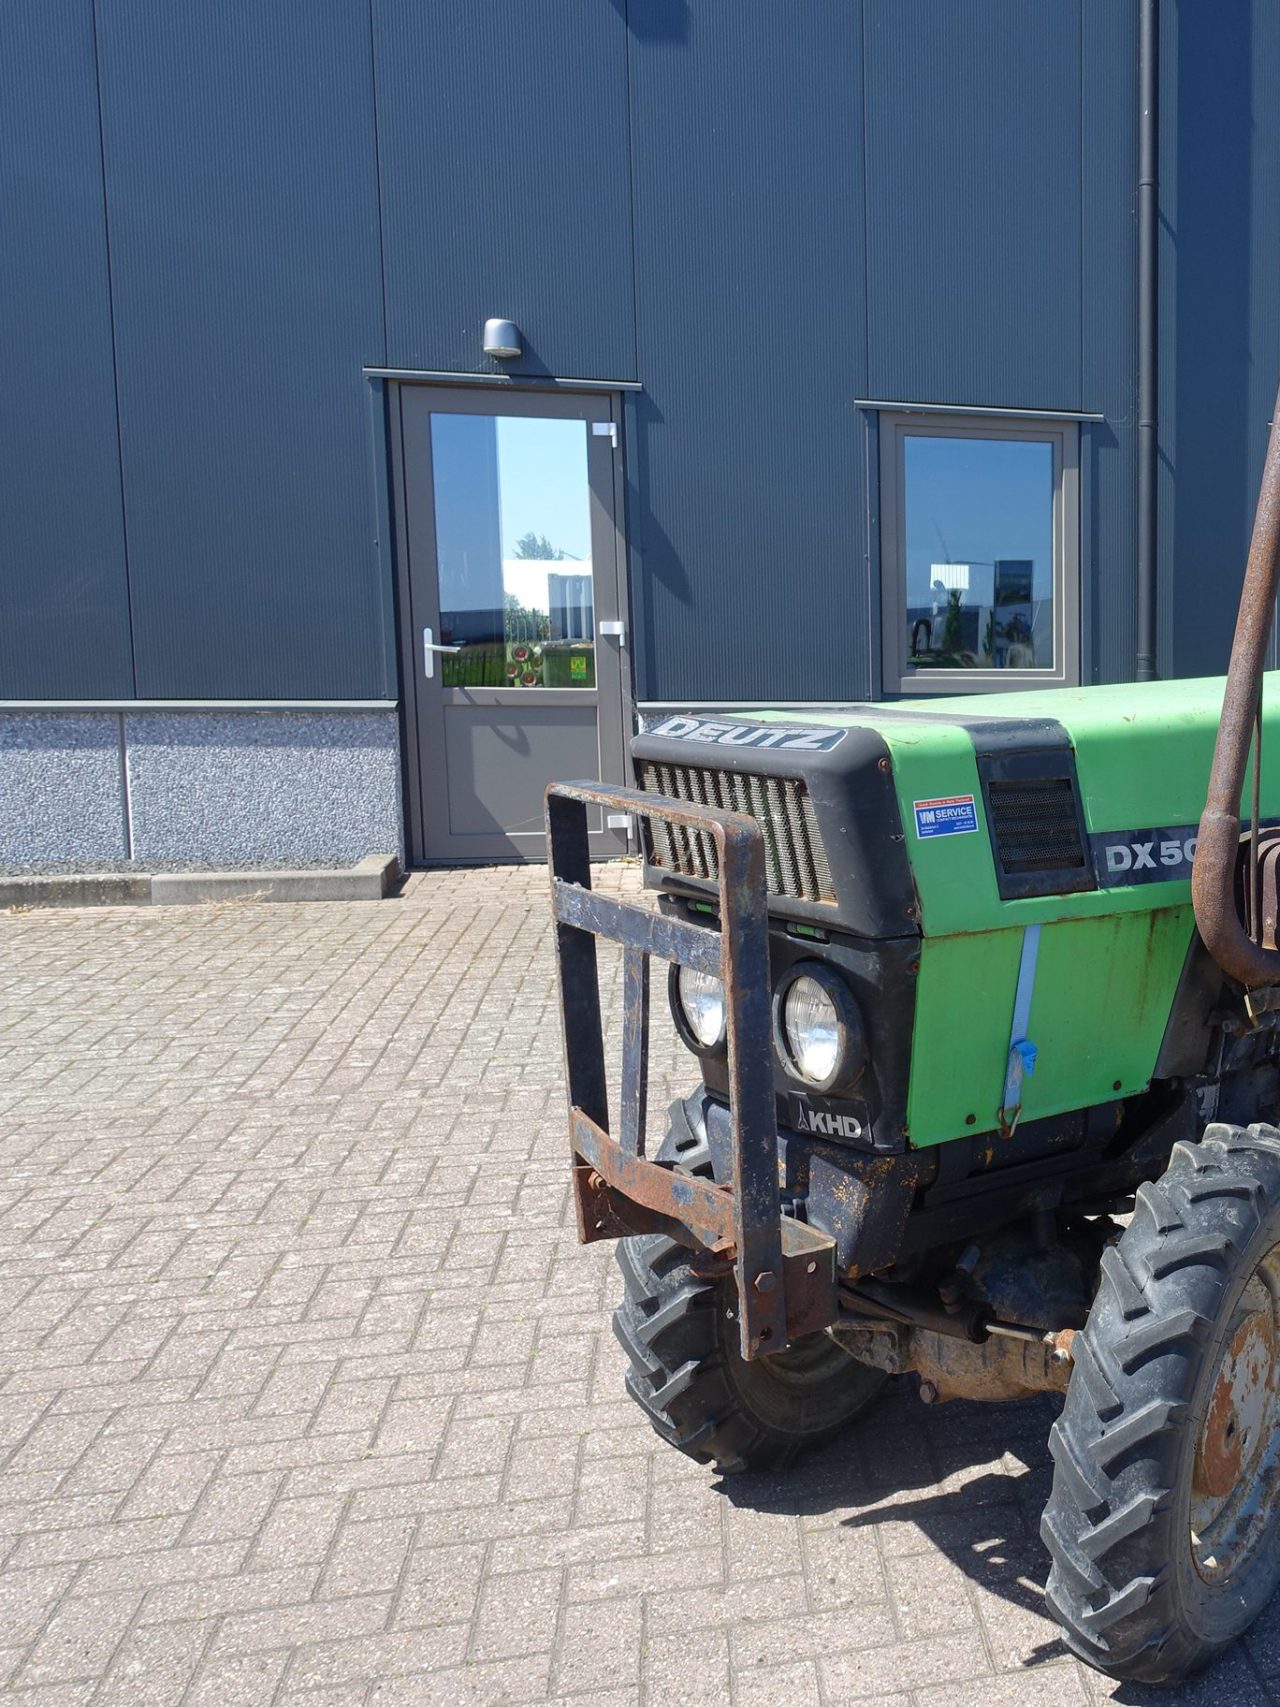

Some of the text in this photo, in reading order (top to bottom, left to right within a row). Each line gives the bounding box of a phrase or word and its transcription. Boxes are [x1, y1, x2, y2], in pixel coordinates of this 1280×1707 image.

[650, 717, 842, 749] DEUTZ
[935, 806, 973, 819] SERVICE
[808, 1110, 862, 1138] KHD
